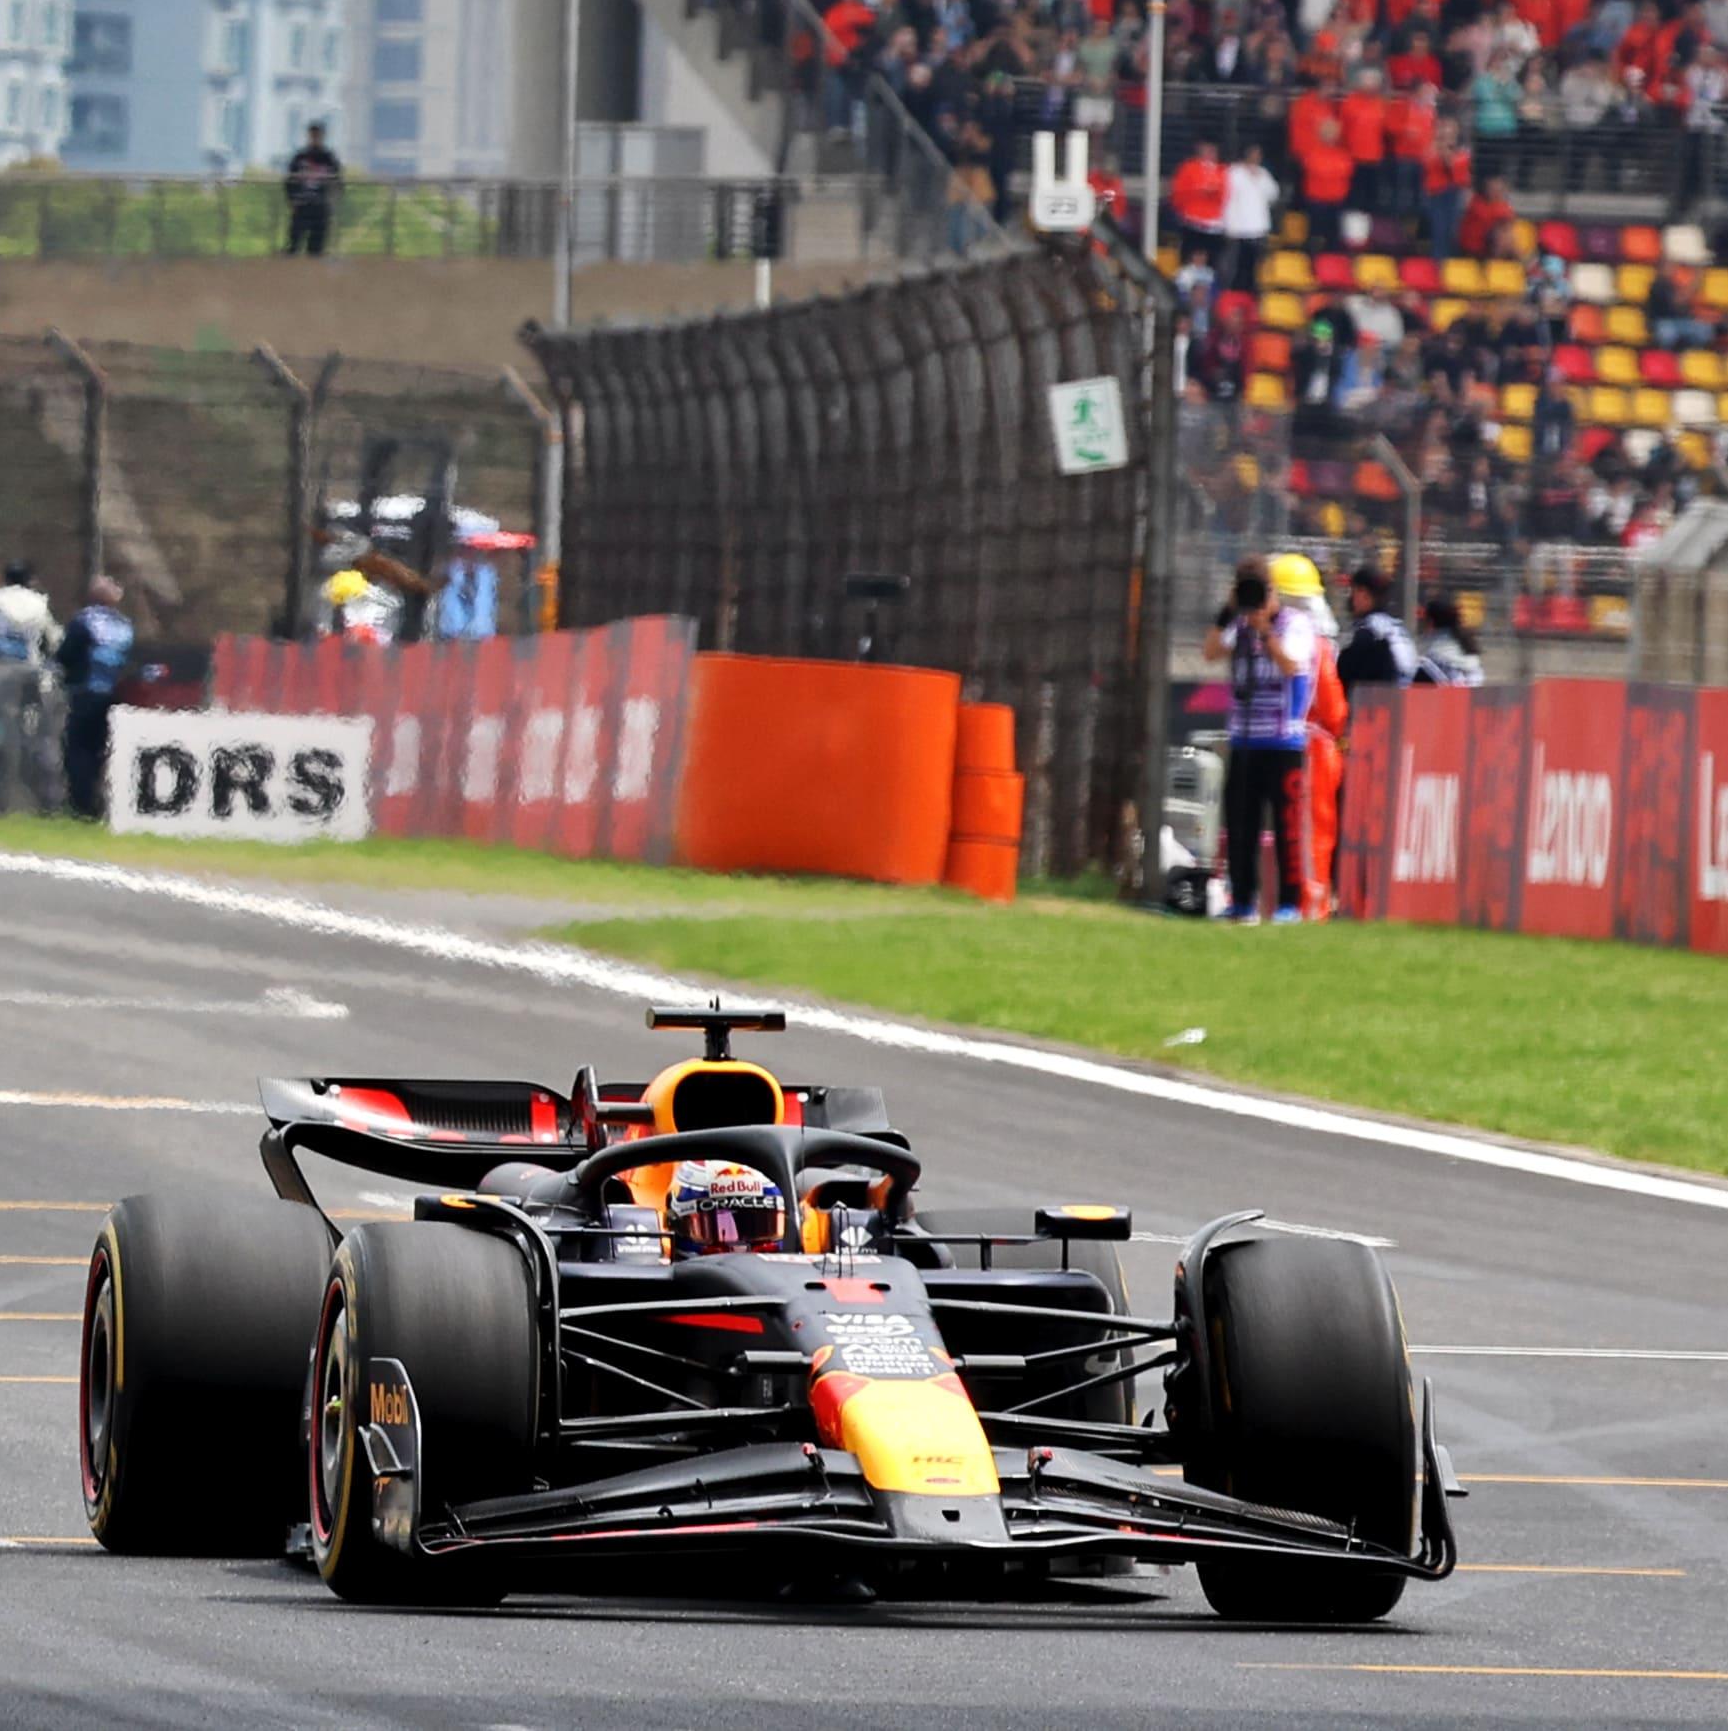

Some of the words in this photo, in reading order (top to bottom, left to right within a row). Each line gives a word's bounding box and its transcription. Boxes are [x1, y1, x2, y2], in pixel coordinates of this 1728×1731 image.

[135, 743, 345, 822] DRS
[710, 1180, 736, 1195] Red
[737, 1180, 761, 1193] Bull
[700, 1196, 775, 1210] ORACLE
[824, 1314, 911, 1325] VISA
[370, 1382, 409, 1424] Mobil
